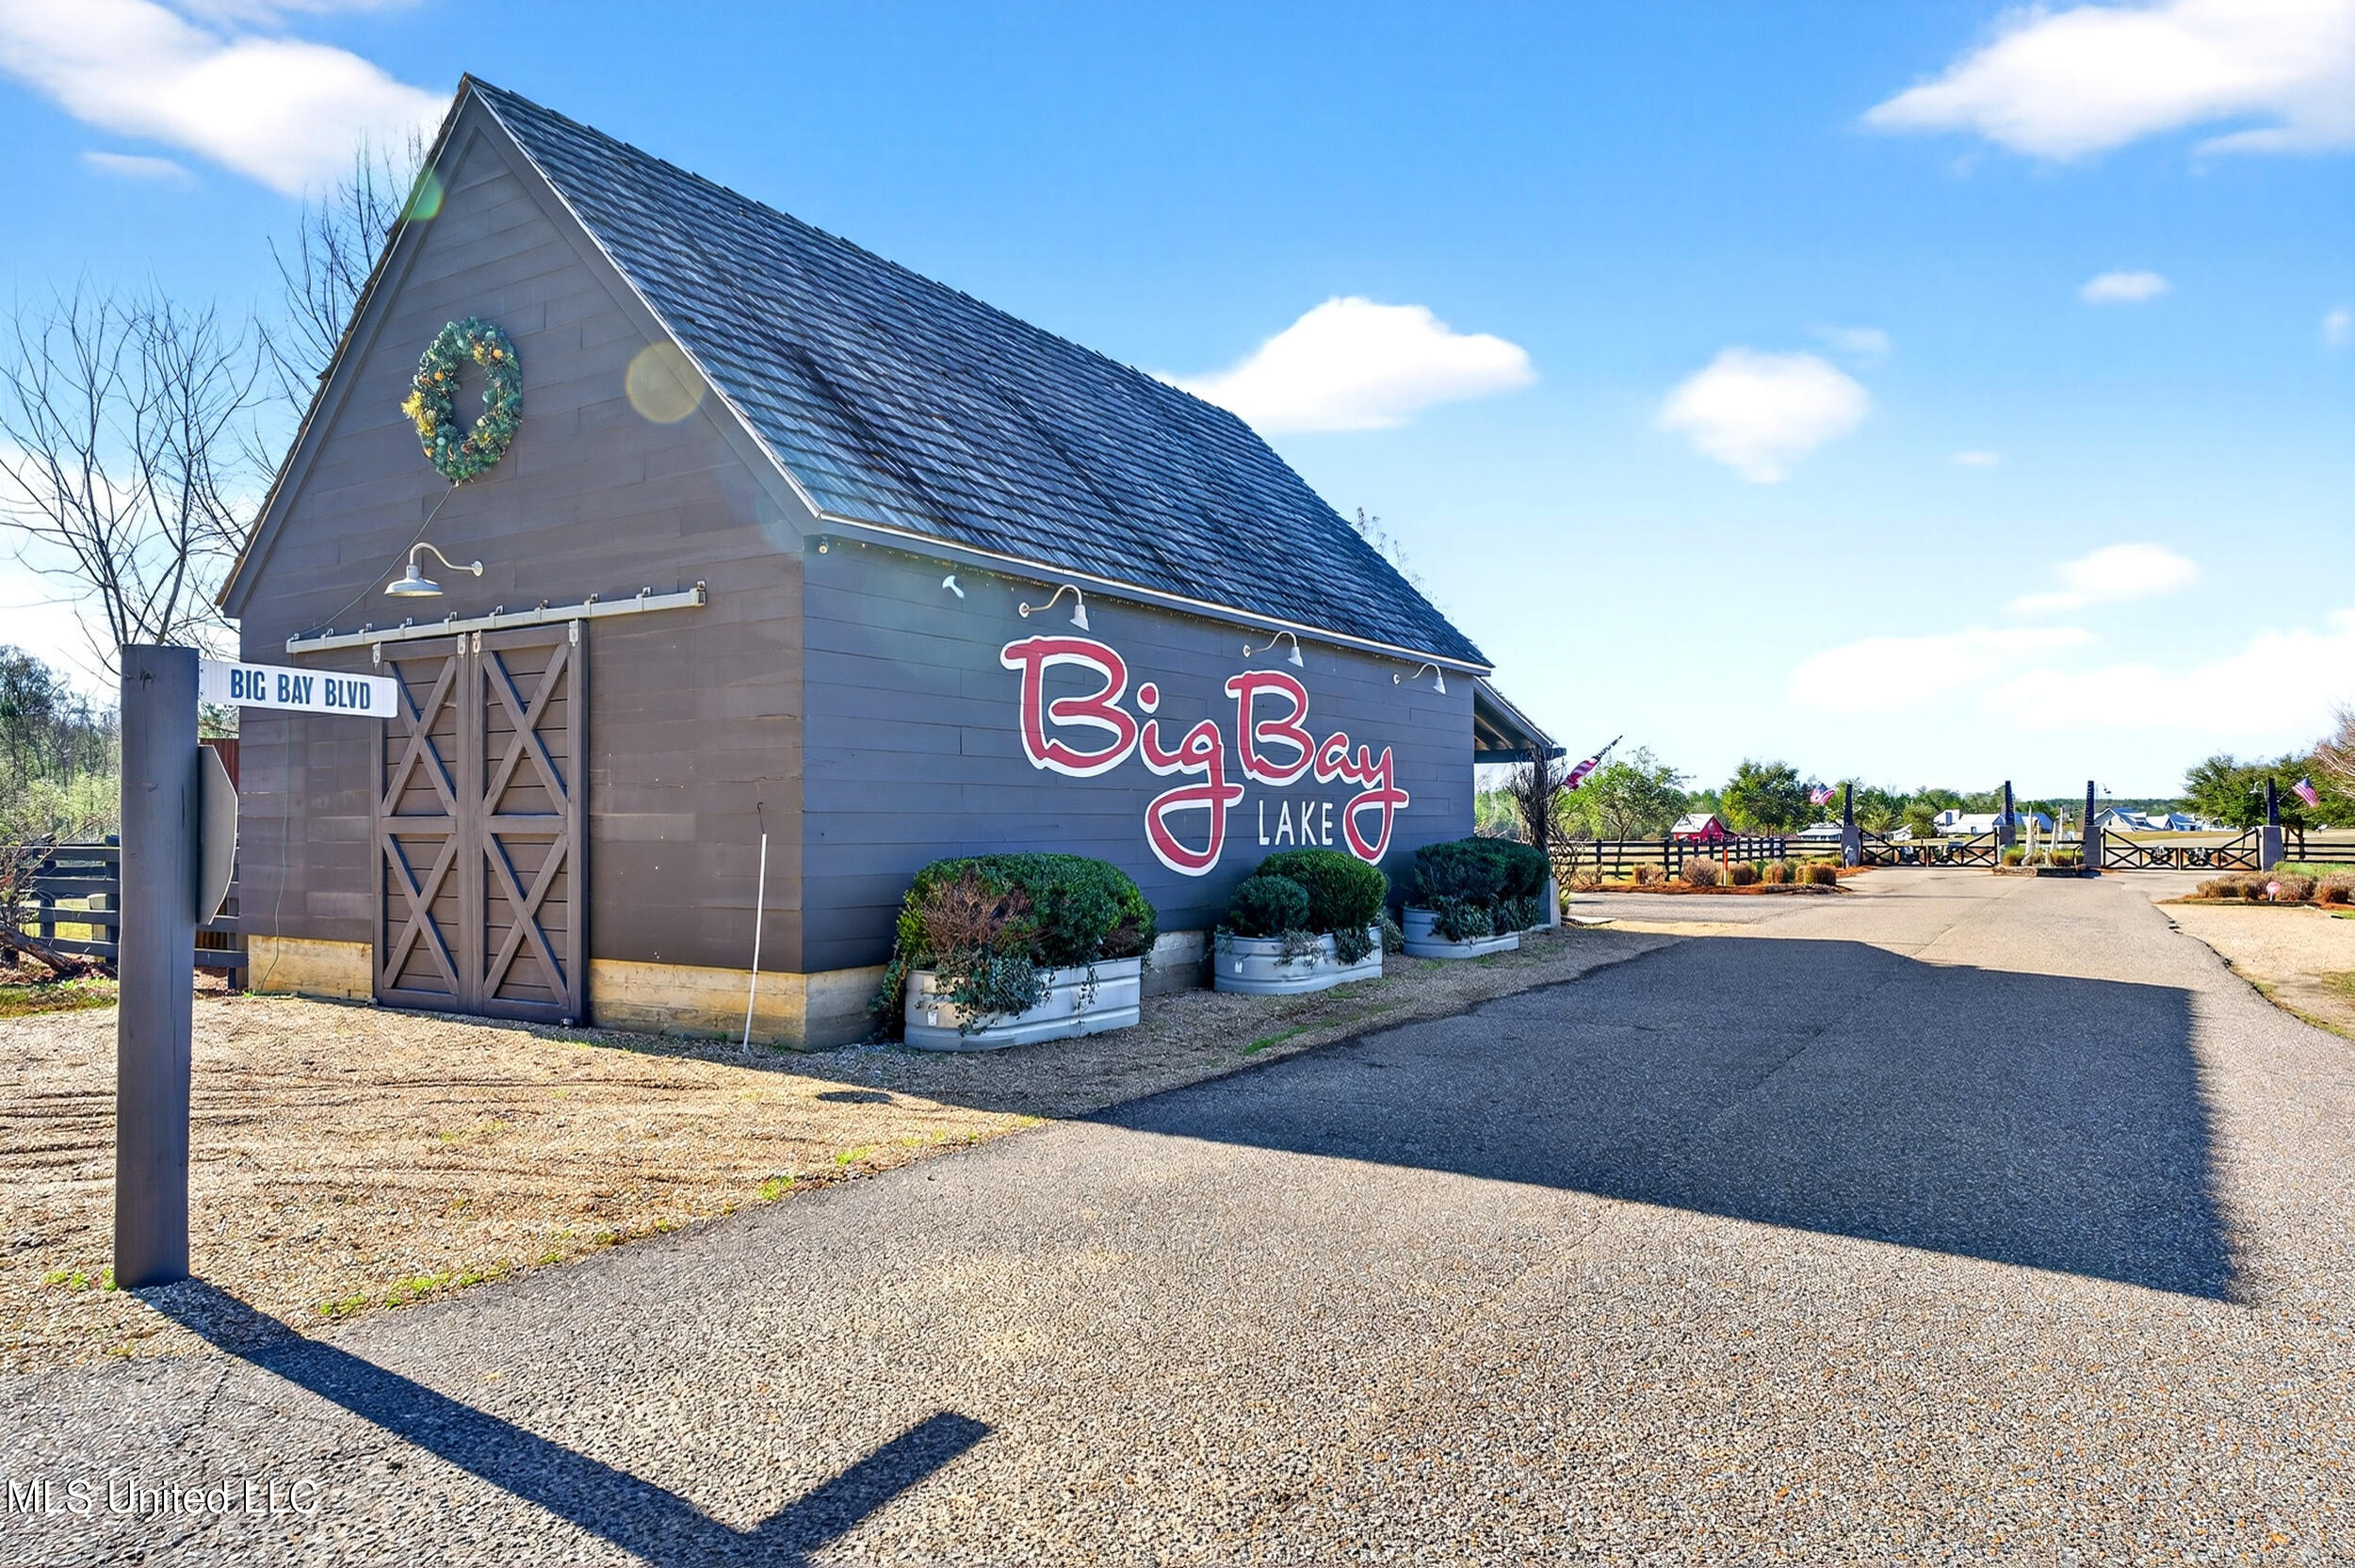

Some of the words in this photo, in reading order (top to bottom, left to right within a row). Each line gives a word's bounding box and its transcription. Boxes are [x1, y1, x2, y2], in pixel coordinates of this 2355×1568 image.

[230, 669, 266, 701] BIG
[278, 674, 314, 704] BAY
[325, 678, 371, 710] BLVD
[999, 635, 1244, 877] Big
[1225, 670, 1409, 865] Bay
[1259, 800, 1334, 846] LAKE
